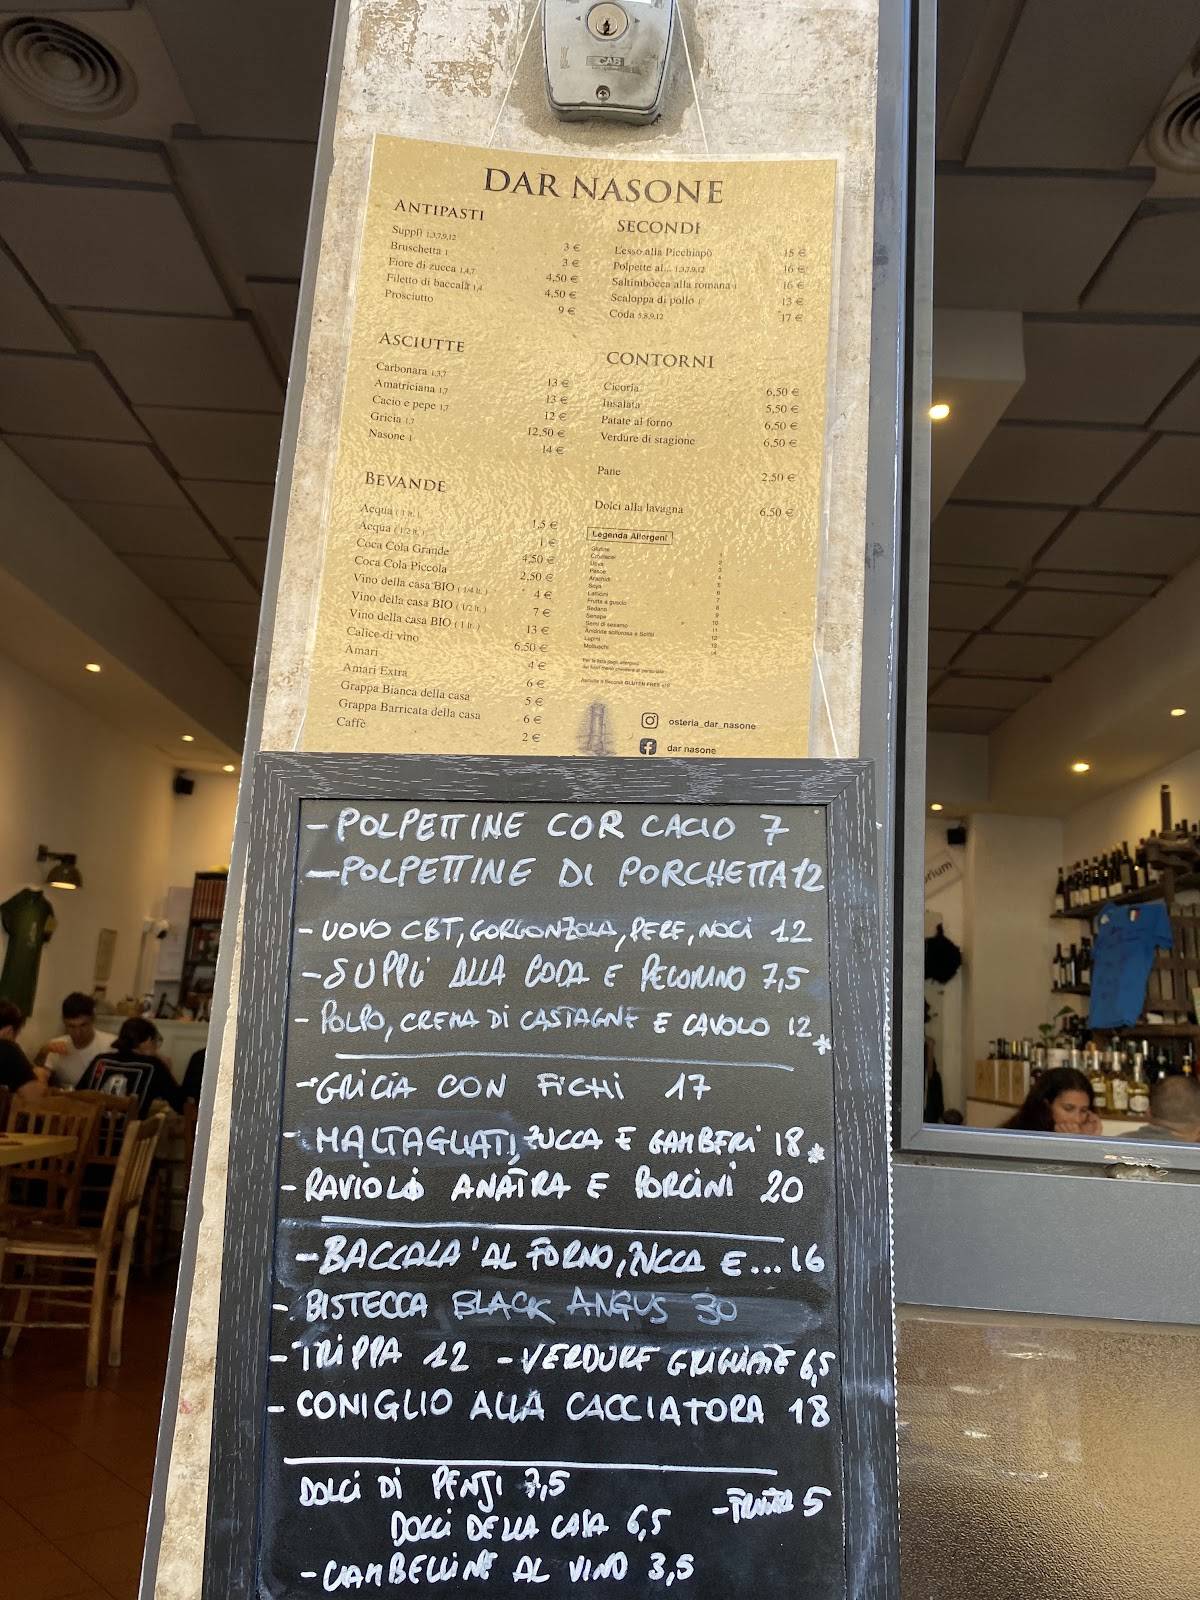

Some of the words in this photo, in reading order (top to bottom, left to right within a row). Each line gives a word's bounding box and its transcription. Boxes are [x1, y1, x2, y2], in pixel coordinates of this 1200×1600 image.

[483, 167, 561, 198] DAR
[572, 175, 723, 204] NASONE
[393, 199, 484, 221] ANTIPASTI
[617, 219, 701, 234] SECONDI
[390, 241, 441, 255] Bruschetta
[389, 257, 413, 270] Fiore
[416, 260, 426, 270] di
[429, 263, 456, 273] zucca
[613, 262, 652, 273] Polpette
[387, 273, 418, 286] Filetto
[421, 277, 431, 286] di
[612, 278, 671, 289] Saltimbocca
[674, 279, 691, 289] alla
[695, 282, 730, 290] romana
[385, 289, 434, 302] Prosciutto
[611, 293, 654, 305] Scaloppa
[657, 295, 668, 304] di
[670, 296, 694, 306] pollo
[609, 309, 635, 319] Coda
[378, 332, 464, 353] ASCIUTTE
[607, 351, 714, 369] CONTORNI
[376, 362, 427, 376] Carbonara
[374, 379, 435, 394] Amatriciana
[603, 382, 639, 393] Cicoria
[766, 387, 788, 398] 6,50
[372, 395, 401, 407] Cacio
[404, 400, 409, 408] e
[412, 401, 436, 412] pepe
[766, 404, 787, 414] 5,50
[370, 411, 401, 424] Gricia
[601, 415, 631, 426] Patate
[634, 417, 642, 427] al
[647, 417, 672, 428] forno
[765, 421, 786, 432] 6,50
[368, 429, 405, 441] Nasone
[527, 427, 554, 438] 12,50
[600, 432, 639, 443] Verdure
[642, 434, 651, 444] di
[655, 436, 695, 447] stagione
[763, 438, 785, 449] 6,50
[365, 471, 447, 493] BEVANDE
[597, 466, 621, 476] Pane
[762, 473, 783, 483] 2,50
[595, 500, 621, 511] Dolci
[625, 502, 643, 513] alla
[647, 503, 684, 516] lavagna
[592, 531, 627, 540] Legenda
[631, 533, 668, 542] Allergeni
[357, 537, 382, 550] Coca
[386, 541, 409, 552] Cola
[412, 544, 449, 556] Grande
[355, 555, 380, 568] Coca
[384, 558, 407, 570] Cola
[411, 561, 447, 574] Piccola
[350, 608, 374, 620] Vino
[378, 612, 402, 623] della
[405, 616, 427, 625] casa
[431, 617, 451, 628] BIO
[347, 626, 380, 638] Calice
[383, 629, 393, 640] di
[397, 632, 419, 643] vino
[345, 644, 378, 657] Amari
[343, 662, 376, 675] Amari
[380, 666, 408, 678] Extra
[341, 680, 379, 694] Grappa
[382, 685, 417, 697] Bianca
[421, 688, 445, 700] della
[448, 692, 470, 701] casa
[339, 699, 377, 712] Grappa
[380, 703, 428, 716] Barricata
[431, 707, 455, 718] della
[459, 711, 481, 720] casa
[336, 716, 366, 729] Caffè
[668, 718, 756, 730] osteria_dar_nasone
[667, 744, 681, 753] dar
[684, 746, 716, 755] nasone
[336, 808, 528, 843] POLPETTINE
[548, 809, 625, 841] COR
[641, 813, 736, 840] CACIO
[760, 813, 790, 846] 7
[340, 855, 536, 887] POLPETTINE
[559, 857, 594, 888] DI
[619, 856, 787, 888] PORCHETTA
[791, 857, 825, 892] 12
[322, 919, 392, 941] UOVO
[770, 918, 813, 943] 12
[448, 954, 505, 989] ALLA
[525, 953, 590, 988] CODA
[604, 963, 624, 987] E
[762, 962, 810, 993] 7,5
[400, 1008, 480, 1032] CREMA
[519, 1006, 640, 1032] CASTAGNE
[653, 1012, 672, 1034] E
[682, 1013, 770, 1037] CAVOLO
[316, 1068, 417, 1105] GRICIA
[437, 1073, 506, 1099] CON
[536, 1072, 625, 1100] FICHI
[664, 1072, 711, 1100] 17
[616, 1126, 636, 1150] E
[649, 1124, 761, 1156] GAMBERI
[451, 1167, 571, 1202] ANATRA
[587, 1172, 610, 1199] E
[635, 1160, 737, 1200] PORCINI
[760, 1169, 804, 1203] 20
[791, 1243, 825, 1273] 16
[306, 1288, 428, 1322] BISTECCA
[451, 1288, 557, 1326] BLACK
[566, 1286, 669, 1324] ANGUS
[691, 1293, 738, 1326] 30
[423, 1340, 470, 1372] 12
[297, 1387, 453, 1422] CONIGLIO
[469, 1389, 545, 1424] ALLA
[566, 1391, 764, 1427] CACCIATORA
[788, 1394, 831, 1428] 18
[378, 1466, 402, 1500] DI
[802, 1486, 832, 1517] 5
[467, 1514, 539, 1542] DELLA
[626, 1504, 671, 1542] 6,5
[512, 1555, 550, 1583] AL
[569, 1551, 628, 1583] VINO
[648, 1551, 694, 1587] 3,5
